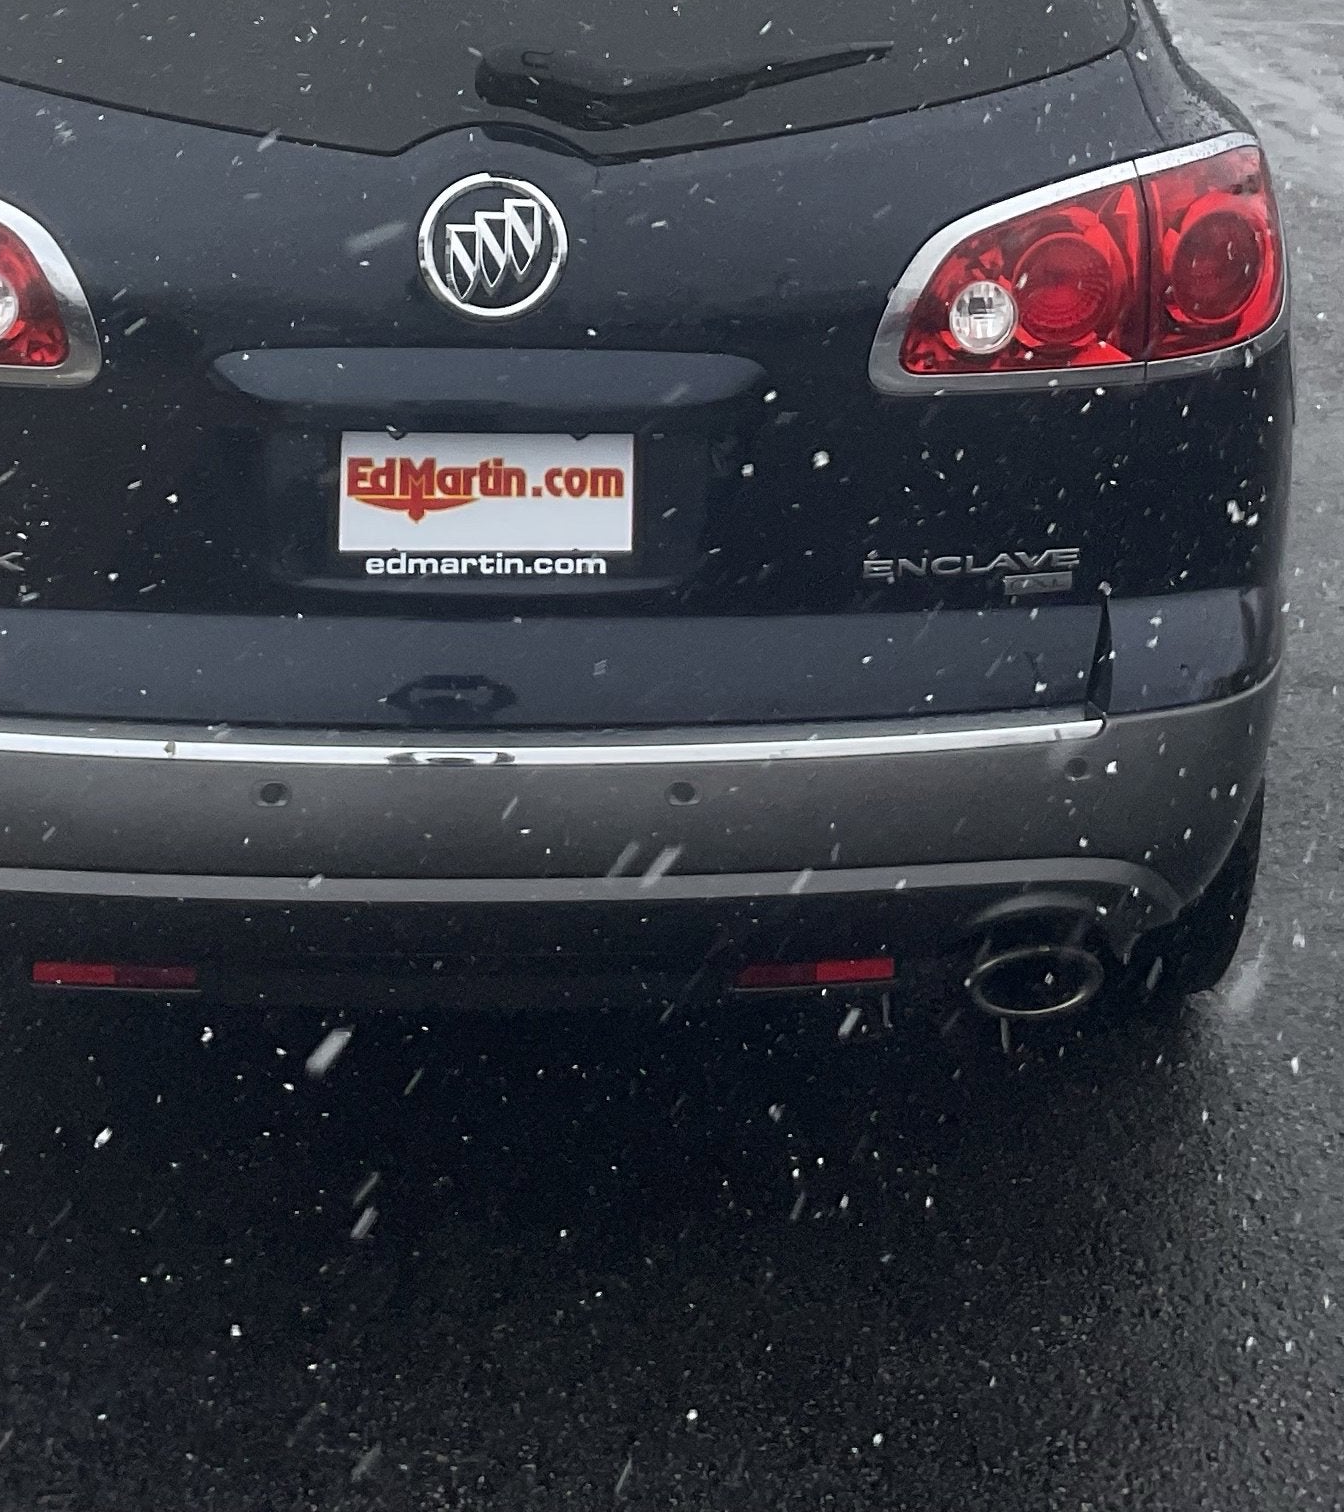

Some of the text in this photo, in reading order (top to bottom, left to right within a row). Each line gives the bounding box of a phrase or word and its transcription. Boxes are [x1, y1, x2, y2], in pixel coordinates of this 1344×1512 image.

[346, 457, 625, 506] EdMartin.com
[365, 552, 607, 575] edmartin.com
[862, 547, 1081, 579] ENCLAVE
